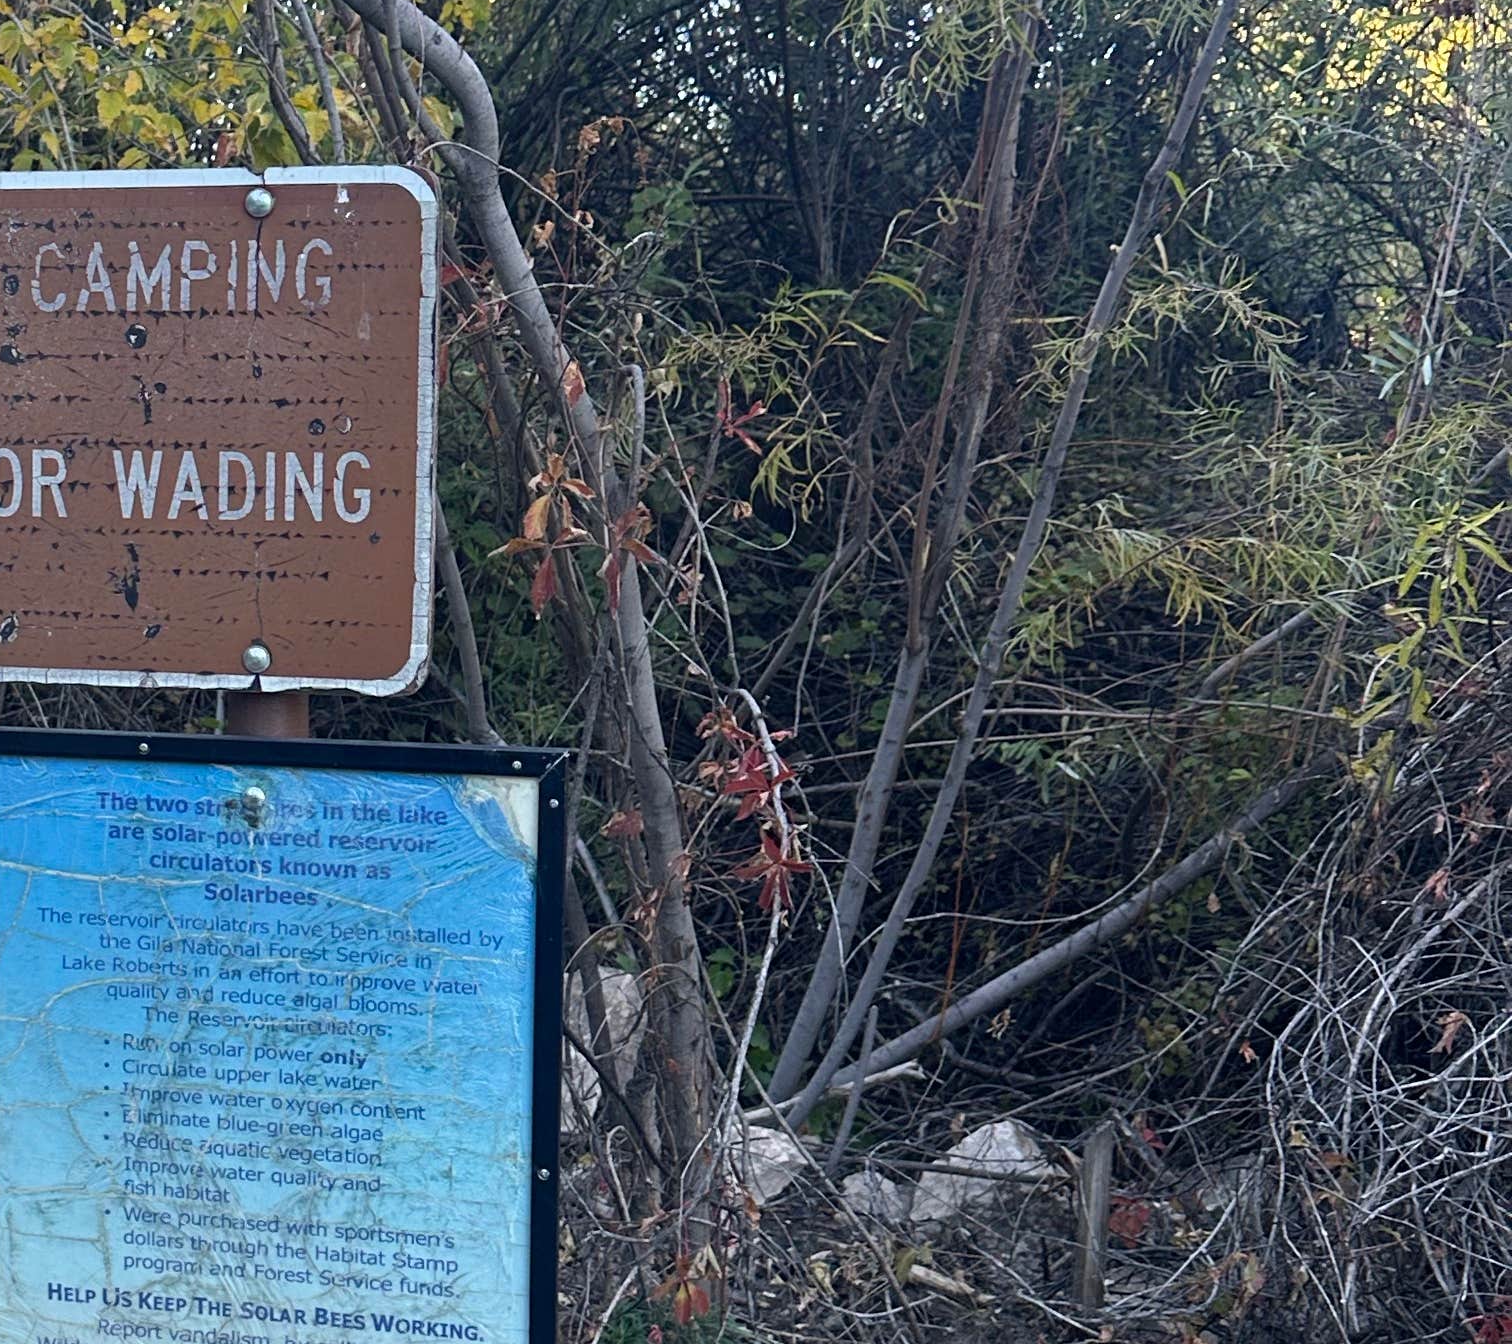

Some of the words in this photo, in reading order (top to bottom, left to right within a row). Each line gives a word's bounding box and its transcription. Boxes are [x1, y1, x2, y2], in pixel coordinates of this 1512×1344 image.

[30, 237, 333, 313] CAMPING
[112, 449, 372, 524] WADING
[108, 825, 144, 840] are
[152, 824, 320, 849] solar-powered
[328, 833, 438, 853] reservoir
[149, 853, 272, 874] circulators
[279, 856, 356, 879] known
[366, 864, 391, 880] as
[38, 907, 72, 924] The
[79, 912, 164, 929] reservoir
[168, 914, 269, 934] circulators
[277, 920, 322, 937] have
[331, 923, 378, 941] been
[389, 928, 471, 945] installed
[479, 930, 503, 951] by
[100, 934, 131, 950] the
[137, 935, 173, 953] Gila
[182, 938, 260, 957] National
[270, 943, 328, 962] Forest
[336, 946, 408, 968] Service
[416, 954, 432, 969] in
[62, 955, 105, 972] Lake
[113, 957, 186, 977] Roberts
[194, 963, 210, 979] in
[218, 966, 241, 980] an
[249, 965, 299, 984] effort
[309, 970, 328, 986] to
[336, 973, 416, 993] improve
[424, 981, 479, 995] water
[107, 982, 169, 1001] quality
[176, 985, 214, 1002] and
[221, 987, 286, 1006] reduce
[292, 992, 337, 1011] algal
[349, 997, 424, 1016] blooms.
[142, 1006, 178, 1024] The
[122, 1033, 158, 1052] Run
[169, 1040, 192, 1054] on
[199, 1041, 245, 1057] solar
[254, 1046, 313, 1062] power
[320, 1049, 368, 1069] only
[122, 1059, 207, 1078] Circulate
[215, 1067, 271, 1084] upper
[279, 1069, 317, 1086] lake
[324, 1074, 381, 1091] water
[120, 1082, 203, 1104] Improve
[209, 1092, 265, 1108] water
[271, 1096, 343, 1116] oxygen
[350, 1104, 426, 1121] content
[122, 1106, 210, 1129] Eliminate
[218, 1114, 323, 1138] blue-green
[331, 1124, 383, 1144] algae
[122, 1131, 192, 1153] Reduce
[199, 1139, 272, 1159] aquatic
[278, 1146, 382, 1166] vegetation
[124, 1156, 204, 1177] Improve
[210, 1166, 265, 1182] water
[271, 1170, 337, 1192] quality
[343, 1177, 381, 1193] and
[124, 1179, 156, 1197] fish
[163, 1182, 231, 1203] habitat
[123, 1206, 172, 1225] Were
[178, 1212, 280, 1233] purchased
[287, 1219, 327, 1238] with
[335, 1225, 455, 1249] sportsmen's
[123, 1229, 184, 1249] dollars
[191, 1236, 269, 1259] through
[276, 1241, 307, 1260] the
[315, 1246, 386, 1267] Habitat
[392, 1251, 459, 1275] Stamp
[123, 1255, 202, 1274] program
[209, 1261, 246, 1278] and
[254, 1263, 312, 1284] Forest
[320, 1269, 393, 1291] Service
[399, 1277, 461, 1299] funds.
[98, 1318, 162, 1341] Report
